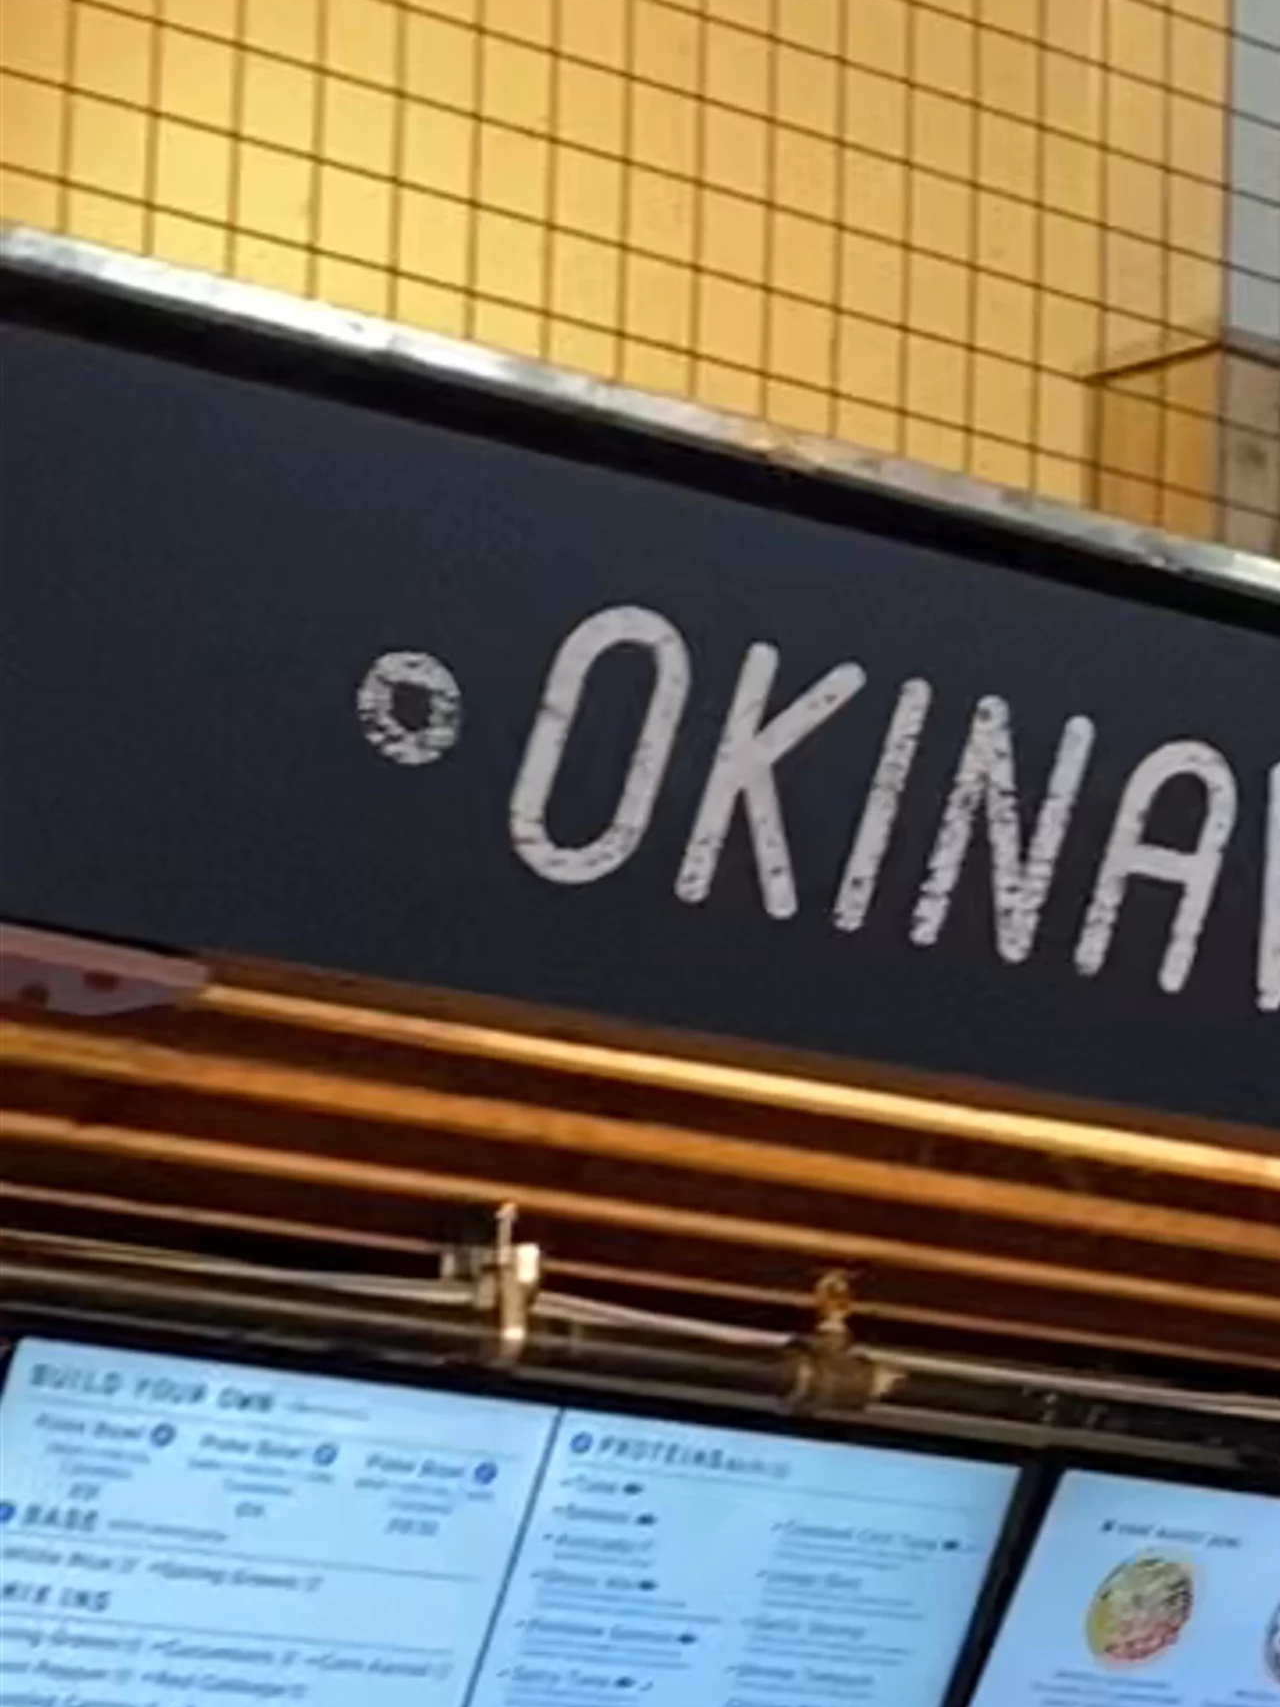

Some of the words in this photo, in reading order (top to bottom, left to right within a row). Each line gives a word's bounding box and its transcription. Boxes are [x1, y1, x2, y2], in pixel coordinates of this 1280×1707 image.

[26, 1361, 122, 1396] BUILD
[132, 1374, 209, 1406] YOUR
[216, 1385, 277, 1414] OWN
[21, 1502, 100, 1532] BASE
